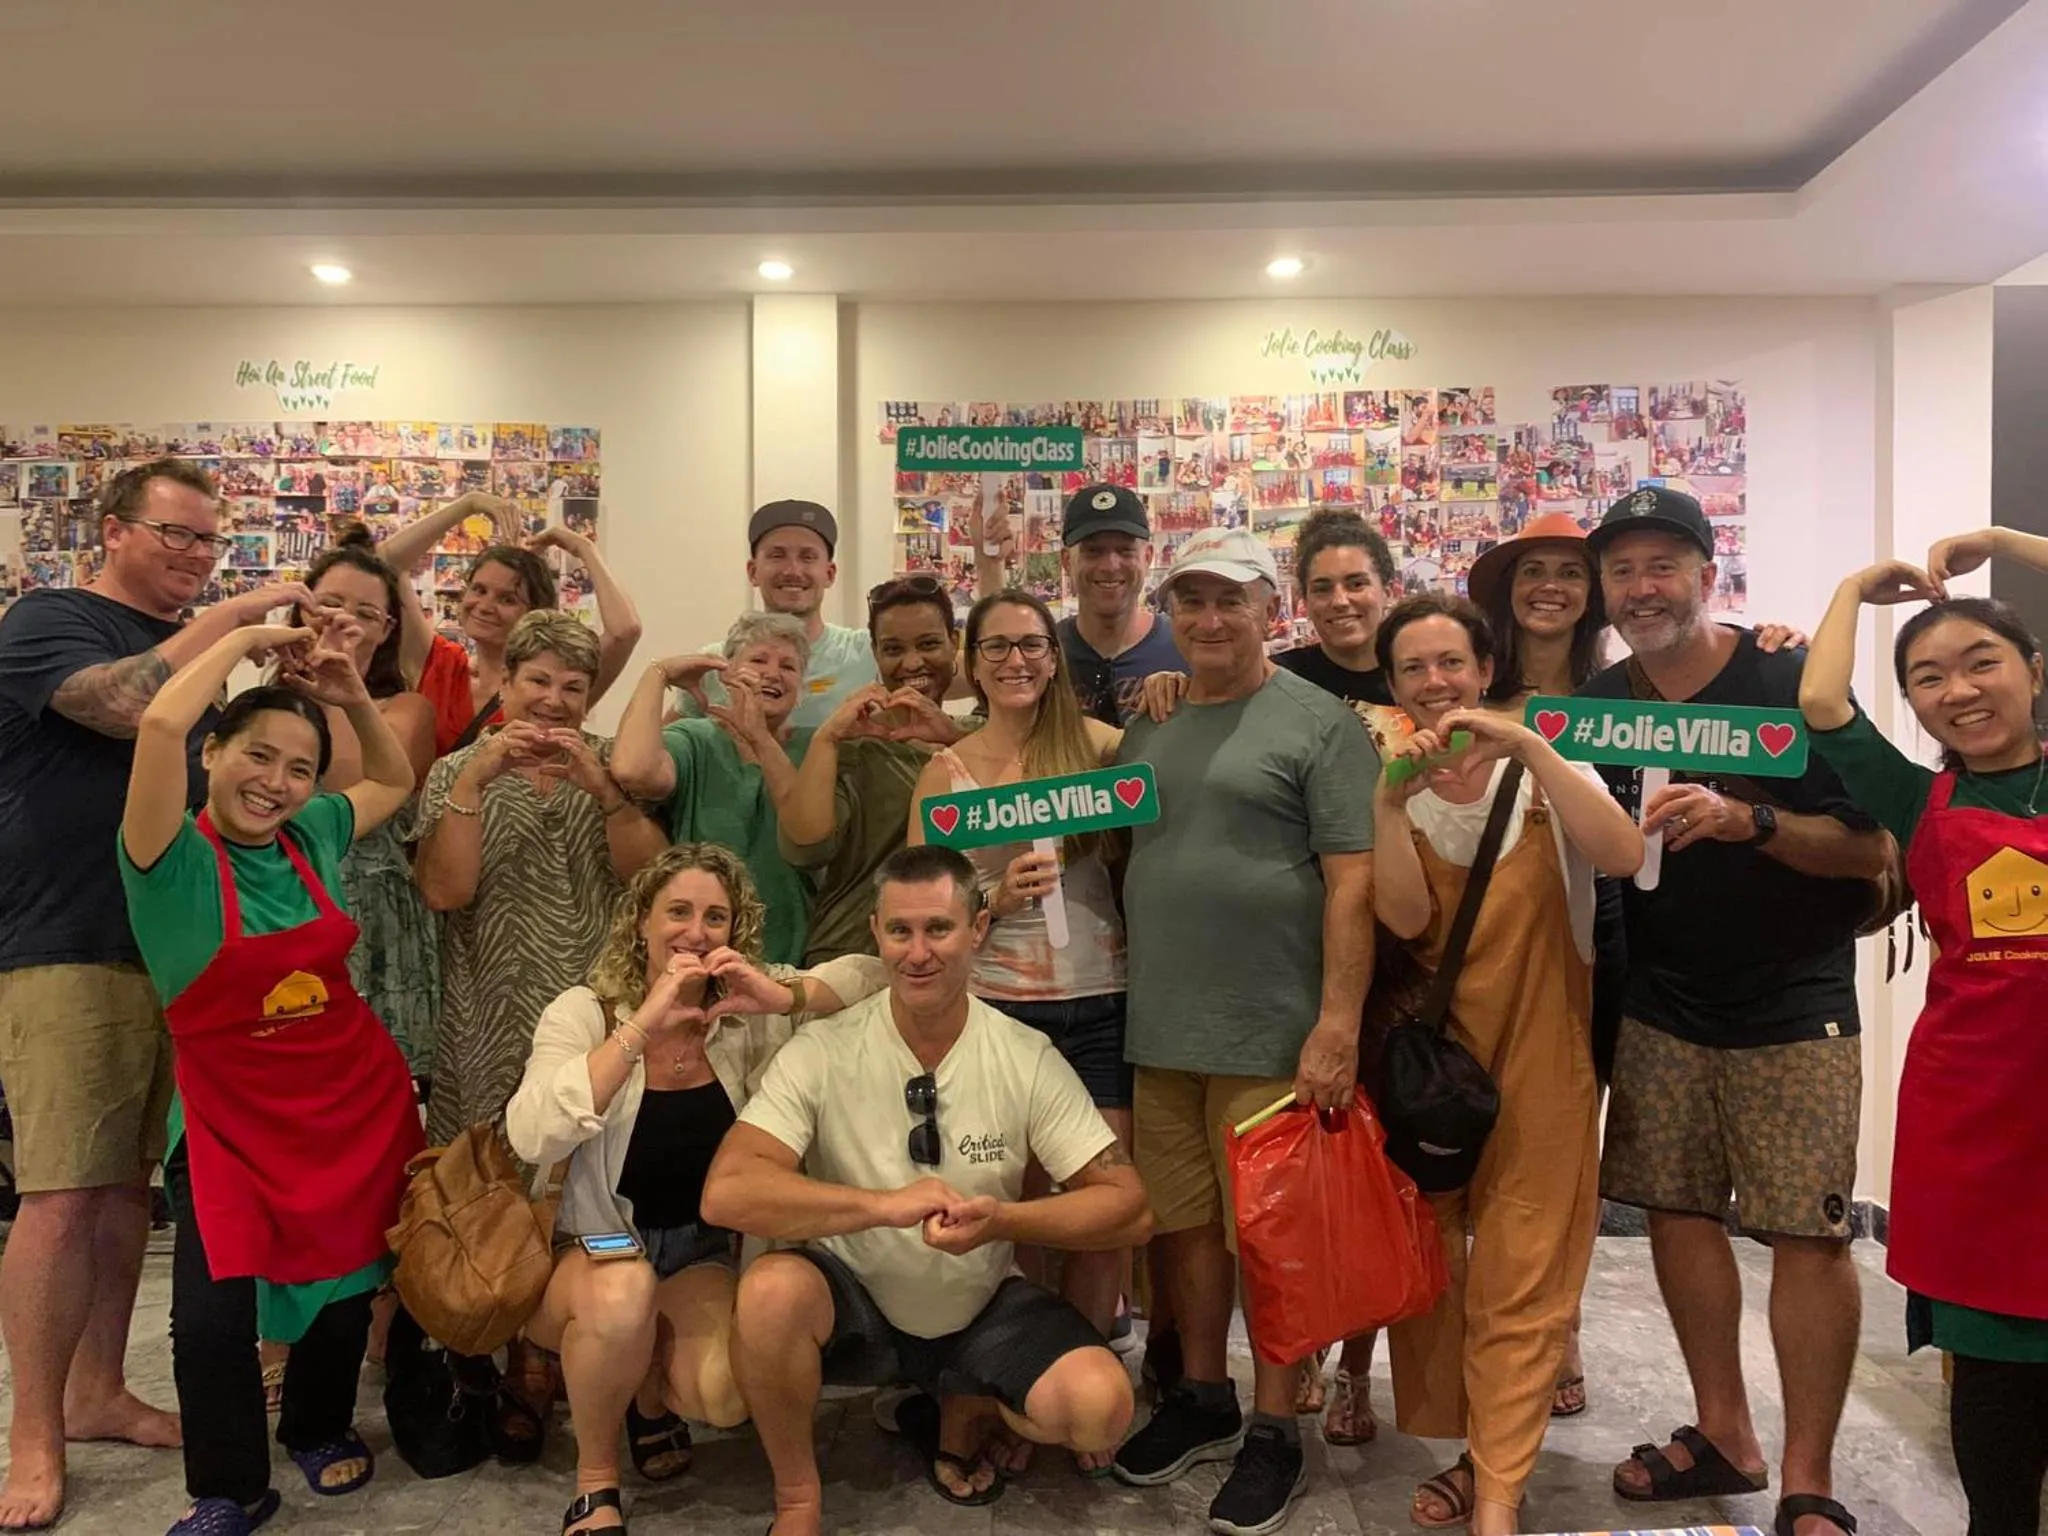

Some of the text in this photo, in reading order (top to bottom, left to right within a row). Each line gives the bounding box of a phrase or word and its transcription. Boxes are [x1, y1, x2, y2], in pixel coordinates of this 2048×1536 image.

[1261, 327, 1413, 366] Jolie Cooking Class
[235, 360, 261, 387] Hoi
[290, 360, 338, 389] Street
[340, 363, 380, 389] Food
[905, 435, 1075, 467] #JolieCookingClass
[1573, 713, 1751, 757] #JolieVilla
[966, 784, 1113, 831] #JolieVilla
[1966, 951, 2001, 962] JOLIE
[969, 1150, 1005, 1164] SLIDE
